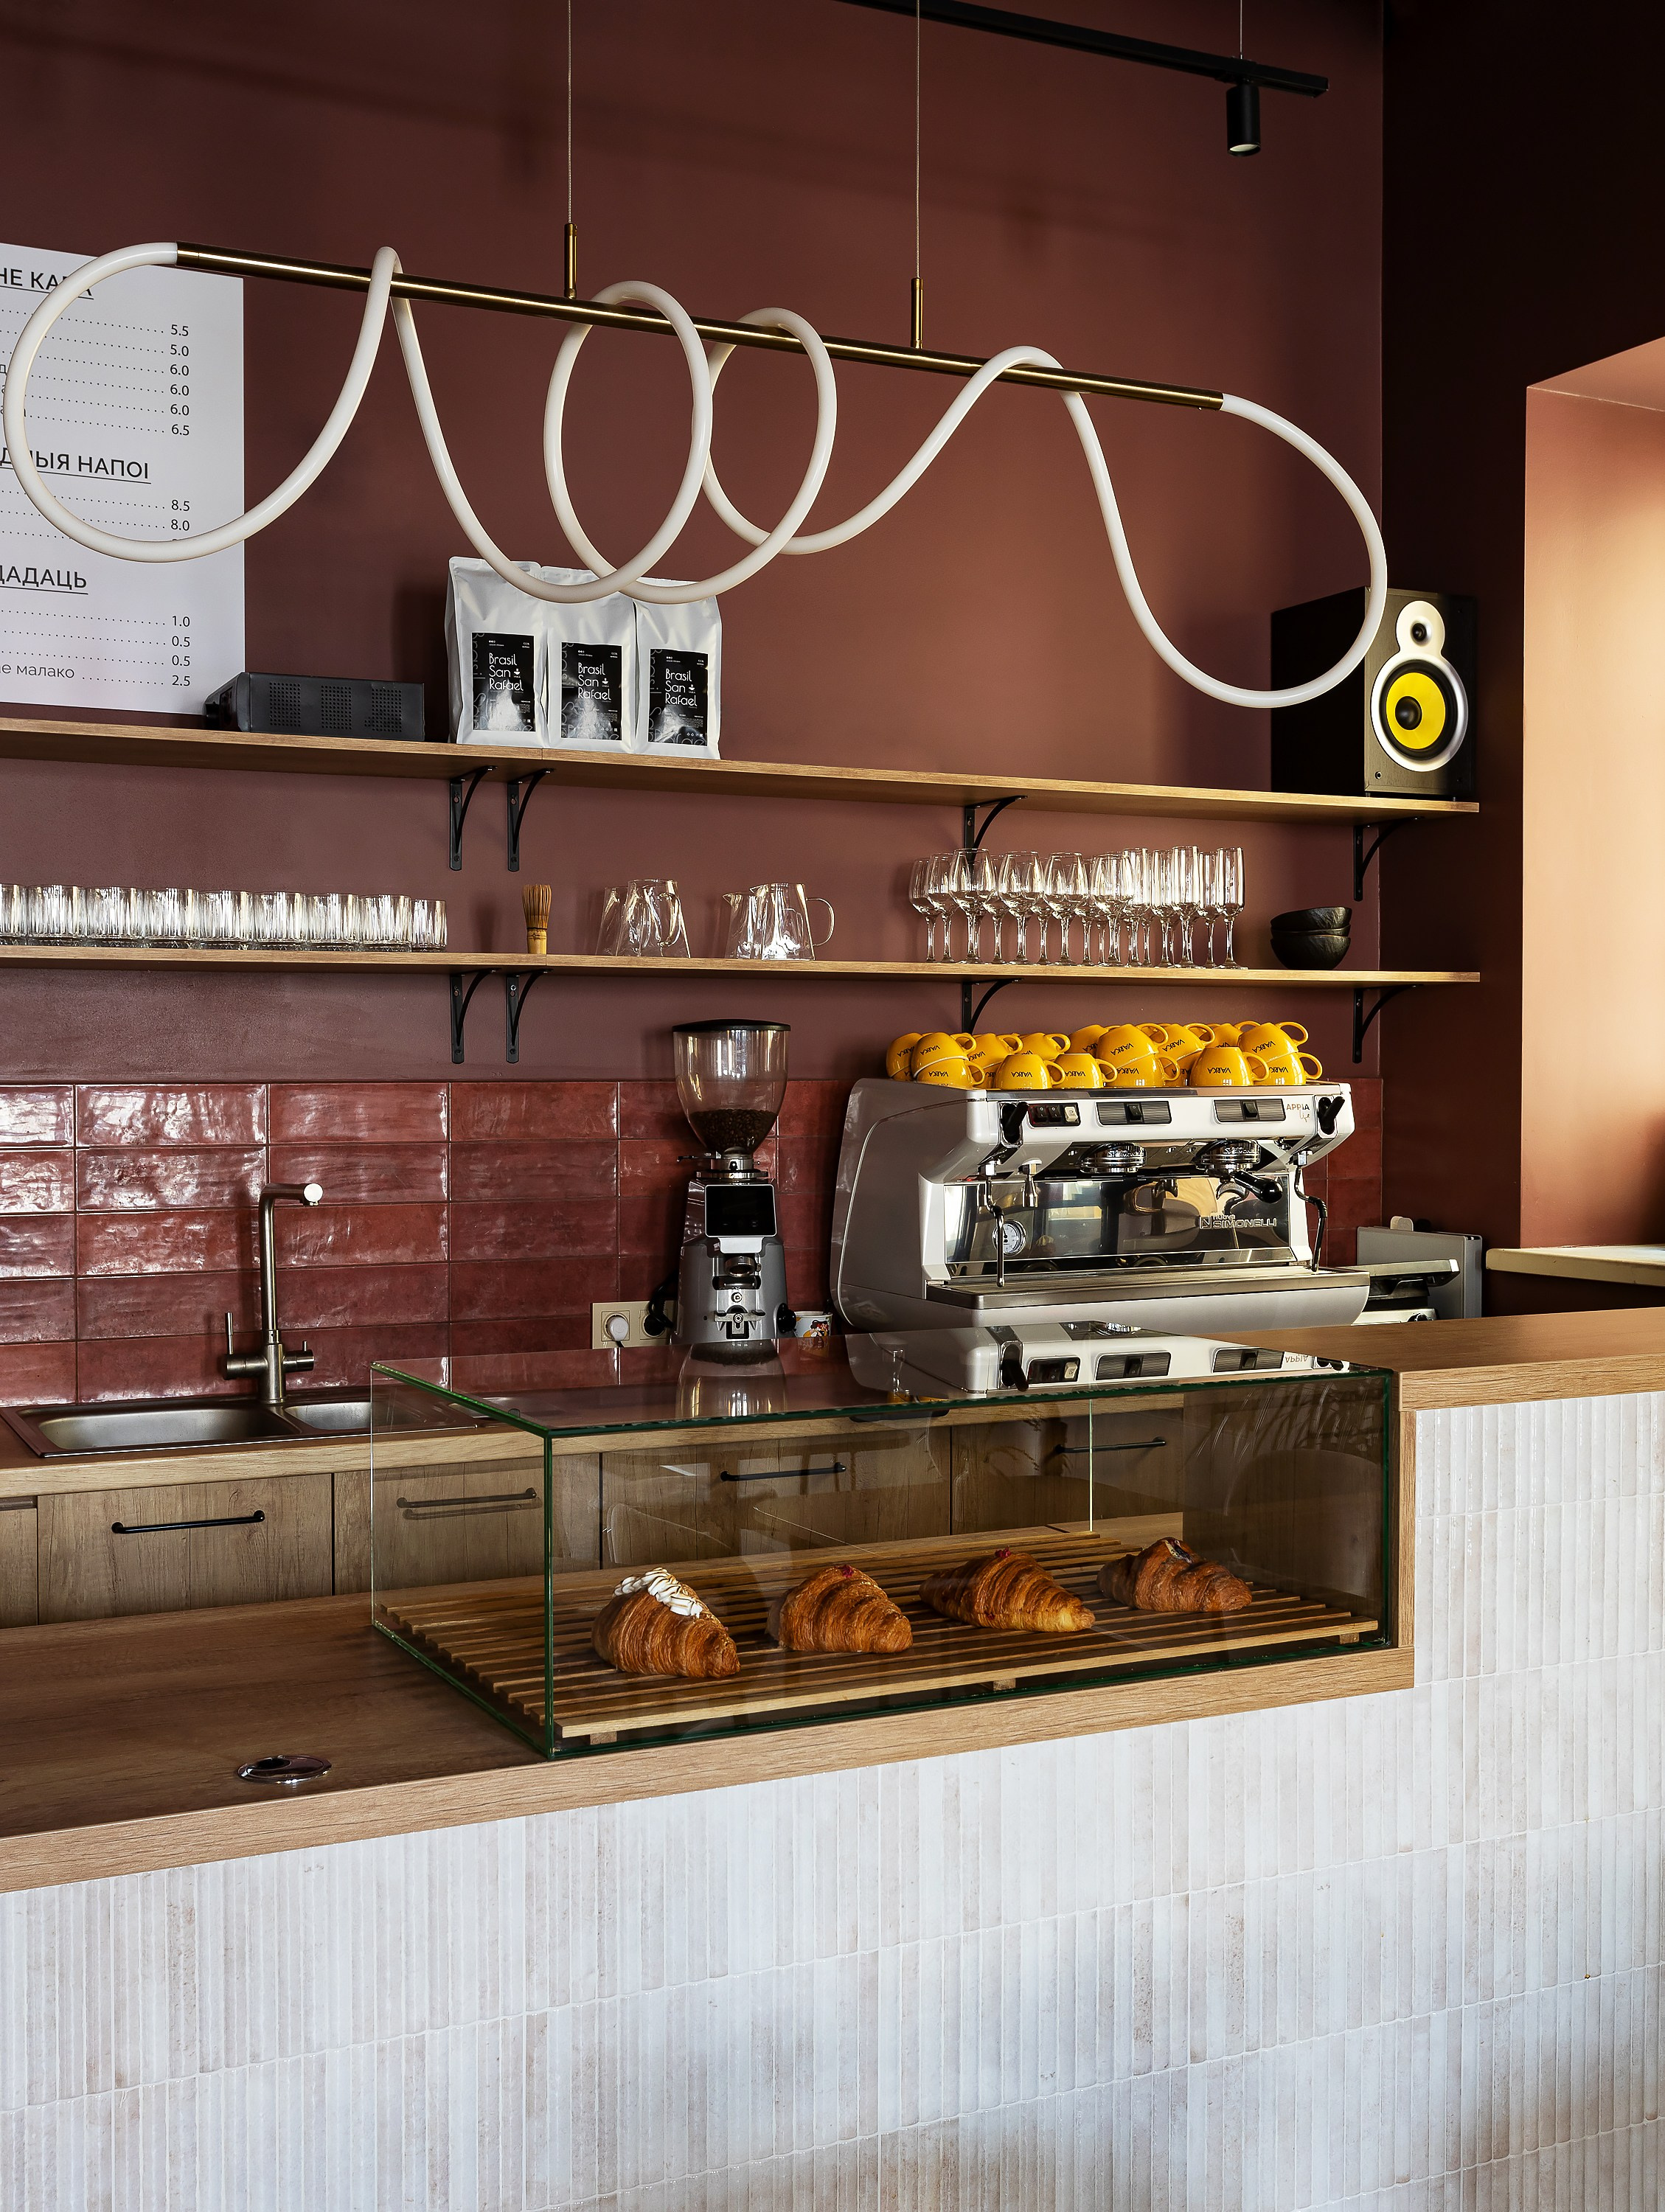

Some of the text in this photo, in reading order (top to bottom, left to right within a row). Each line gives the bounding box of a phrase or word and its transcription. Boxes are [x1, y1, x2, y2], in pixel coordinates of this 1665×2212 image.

[171, 324, 188, 336] 5.5
[170, 344, 189, 356] 5.0
[170, 364, 189, 376] 6.0
[170, 384, 189, 396] 6.0
[170, 404, 189, 415] 6.0
[172, 424, 189, 435] 6.5
[172, 500, 190, 511] 8.5
[171, 519, 190, 531] 8.0
[0, 566, 87, 590] АДАЦЬ
[173, 616, 190, 627] 1.0
[172, 636, 190, 647] 0.5
[172, 655, 190, 666] 0.5
[489, 653, 518, 666] Brasil
[489, 665, 511, 677] San
[578, 662, 605, 675] Brasil
[17, 665, 74, 678] малако
[172, 675, 190, 686] 2.5
[578, 675, 599, 687] San
[666, 668, 692, 682] Brasil
[489, 678, 524, 692] Rafael
[665, 680, 686, 693] San
[578, 687, 611, 700] Rafael
[665, 692, 698, 706] Rafael
[920, 1045, 941, 1056] VARKA
[1110, 1043, 1133, 1055] VARKA
[1162, 1039, 1185, 1052] VARKA
[1252, 1041, 1276, 1054] VARKA
[1213, 1218, 1277, 1229] SIMONELLI
